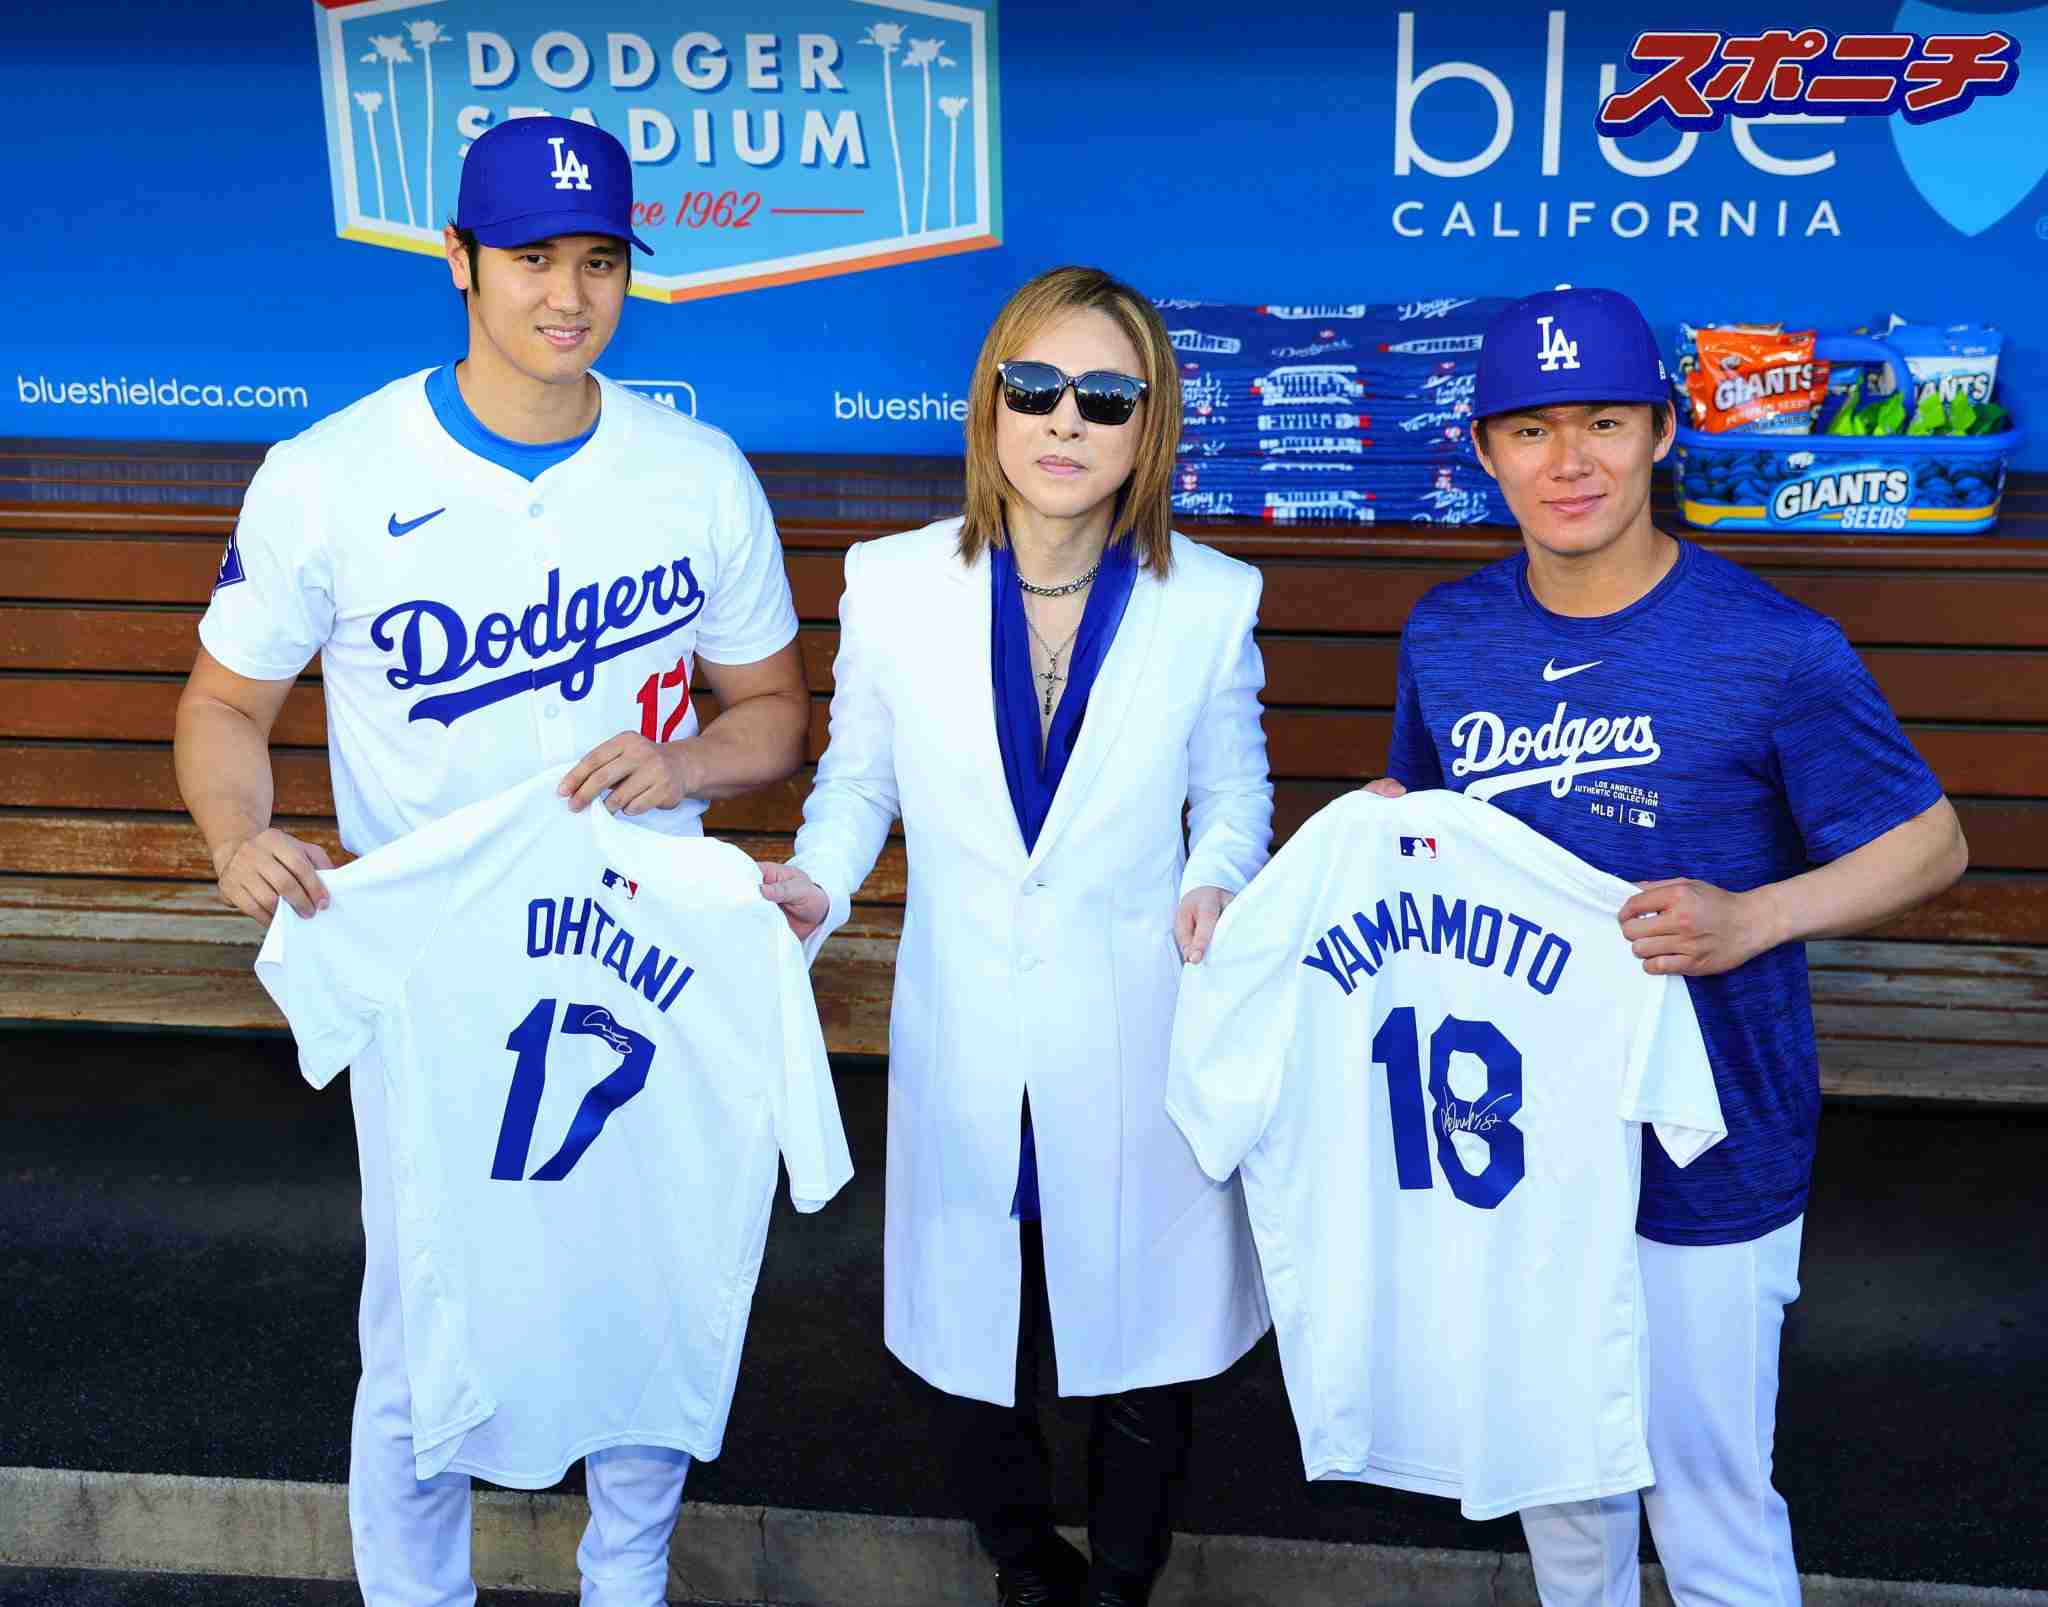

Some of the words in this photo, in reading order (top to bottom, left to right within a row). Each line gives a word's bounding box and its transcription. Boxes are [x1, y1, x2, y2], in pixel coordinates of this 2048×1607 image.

[466, 31, 846, 92] DODGER
[456, 105, 868, 168] SDIUM
[547, 137, 592, 191] LA
[673, 191, 762, 229] 1962
[1392, 201, 1842, 239] CALIFORNIA
[1536, 316, 1581, 372] LA
[17, 375, 309, 409] blueshieldca.com
[834, 391, 969, 421] blueshie
[1714, 363, 1814, 411] GIANTS
[1914, 374, 1989, 402] ANTS
[1775, 470, 1910, 520] GIANTS
[1840, 506, 1908, 530] SEEDS
[370, 556, 706, 708] Dodgers
[636, 655, 690, 744] 17
[1451, 701, 1661, 799] Dodgers
[1574, 785, 1611, 798] AUTHENTIC
[1613, 791, 1658, 807] COLLECTION
[1591, 803, 1615, 818] MLB
[1594, 780, 1608, 789] LOS
[1648, 790, 1659, 799] CA
[526, 896, 695, 1013] OHTANI
[1302, 891, 1573, 996] YAMAMOTO
[490, 998, 657, 1181] 17
[1371, 1006, 1526, 1210] 18
